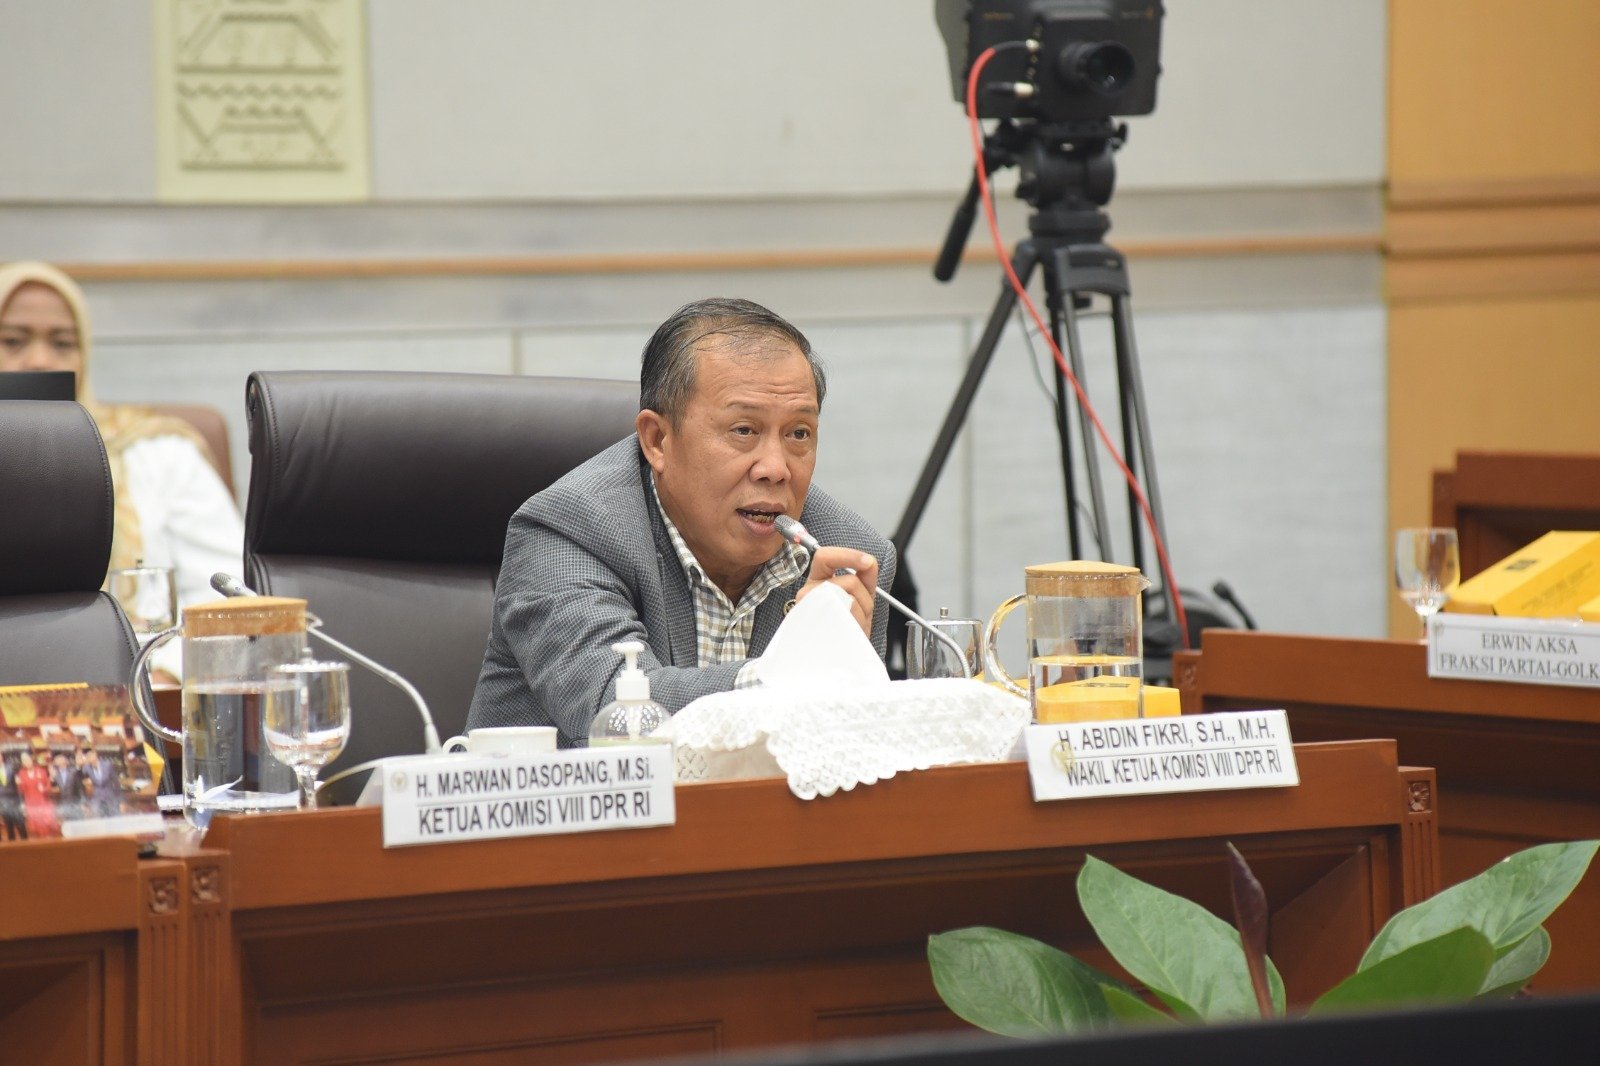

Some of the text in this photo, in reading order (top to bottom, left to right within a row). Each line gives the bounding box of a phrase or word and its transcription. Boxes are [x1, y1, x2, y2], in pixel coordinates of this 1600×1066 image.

[1482, 633, 1578, 655] ERWIN AKSA
[1440, 653, 1494, 673] FRAKSI
[1058, 717, 1275, 753] H. ABIDIN FIKRI, S.H., M.H.
[416, 757, 655, 798] H. MARWAN DASOPANG, M.Si.
[1066, 748, 1282, 787] WAKIL KETUA KOMISI VIII DPR RI
[419, 791, 650, 835] KETUA KOMISI VIII DPR RI
